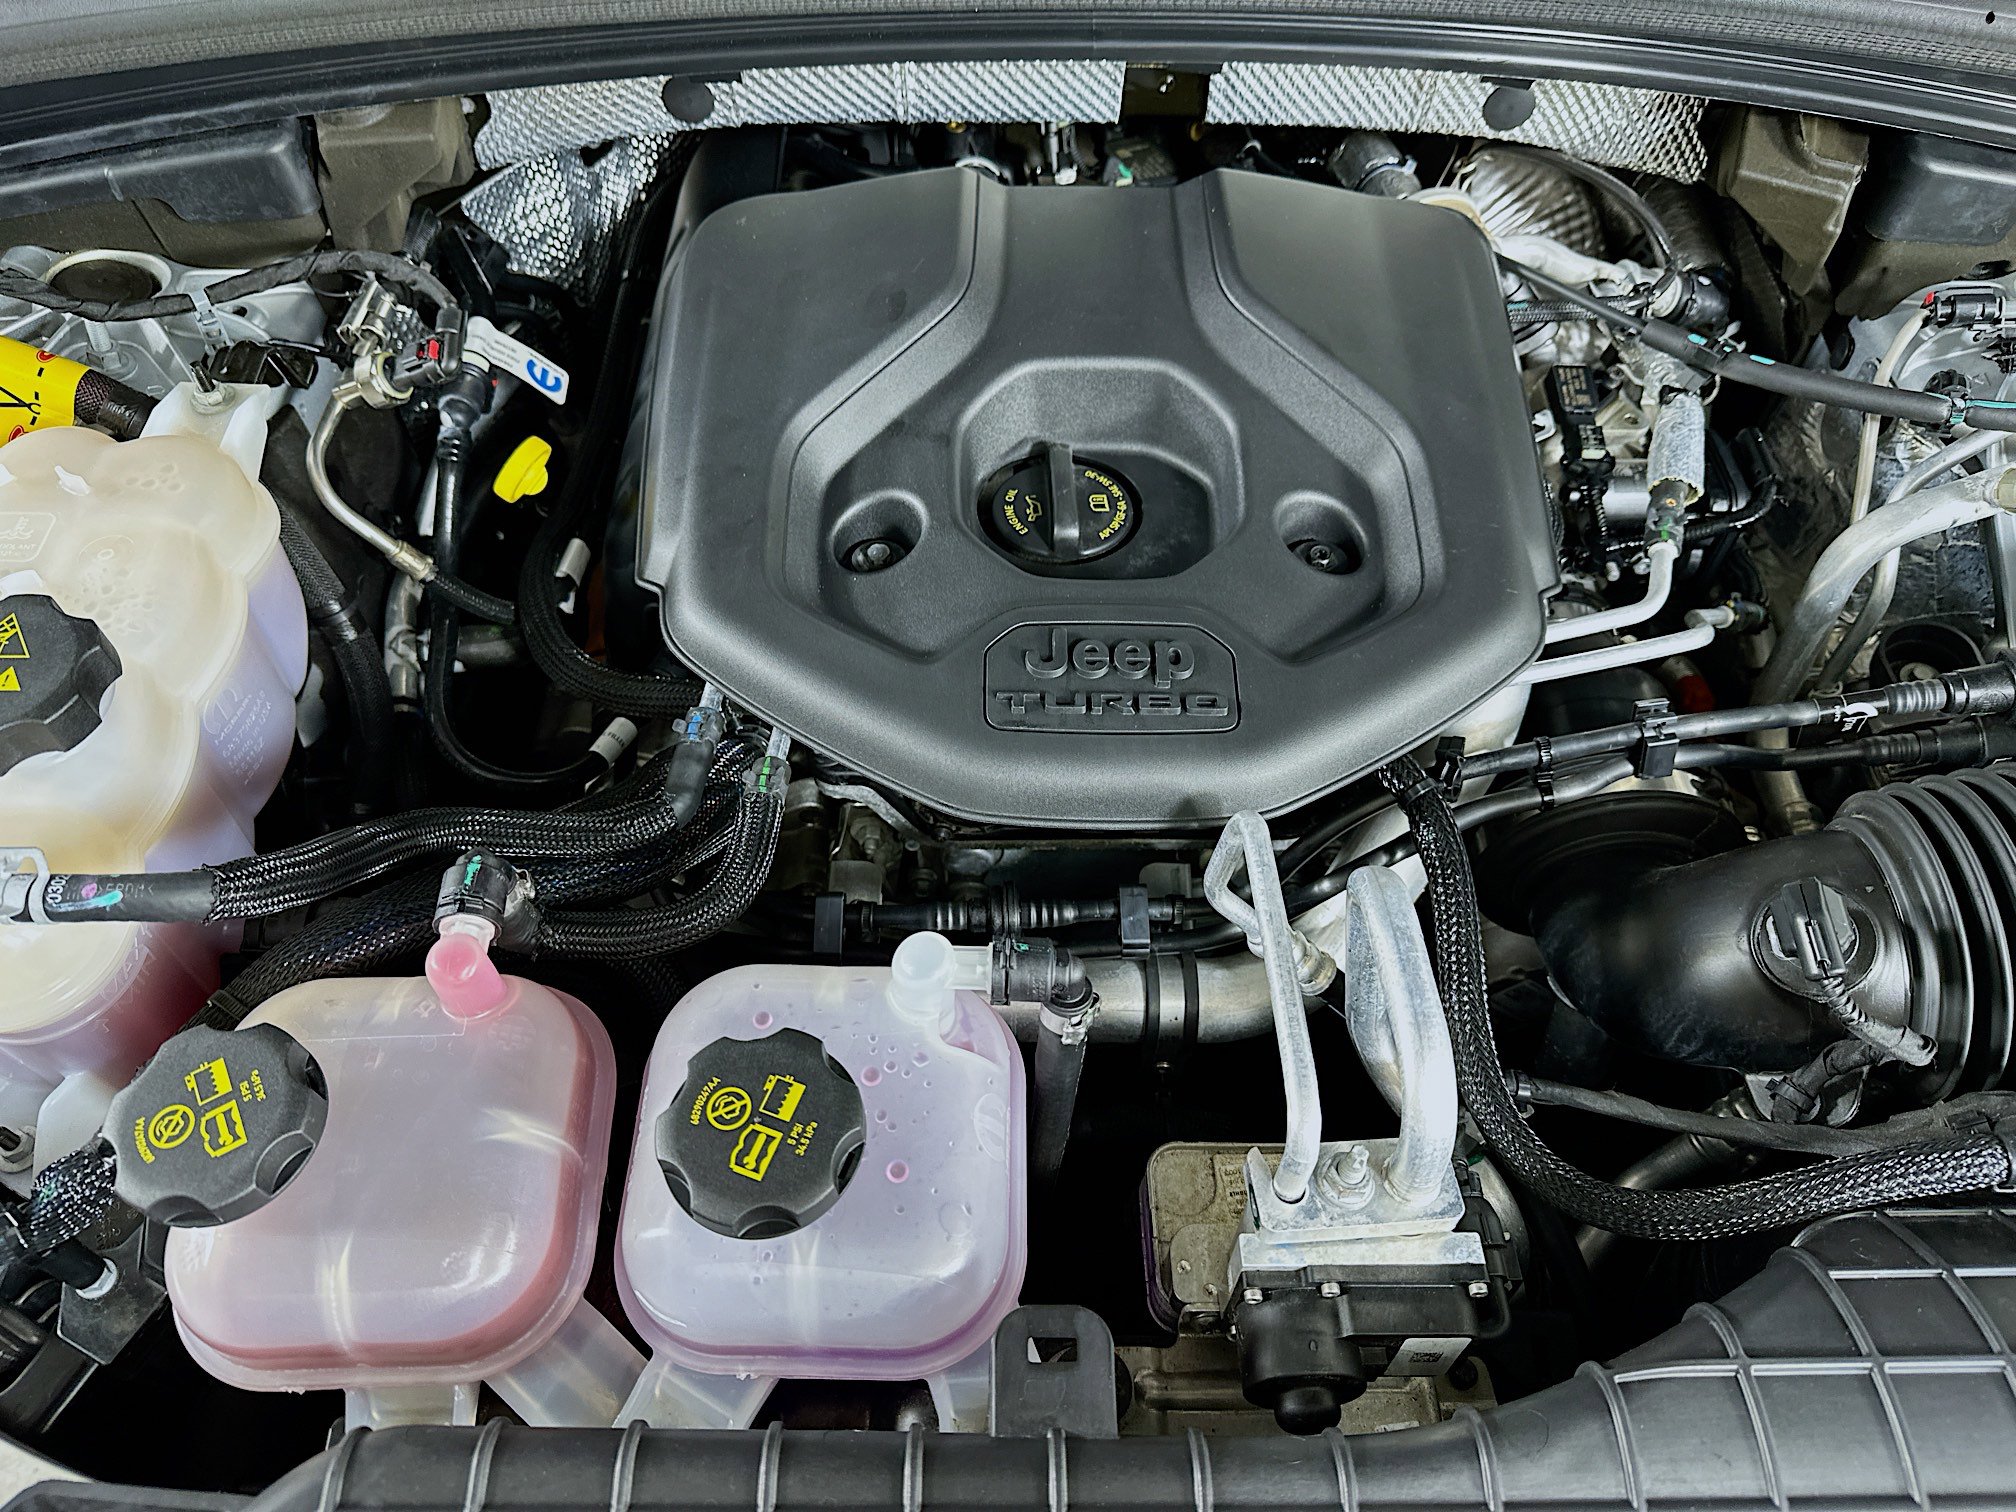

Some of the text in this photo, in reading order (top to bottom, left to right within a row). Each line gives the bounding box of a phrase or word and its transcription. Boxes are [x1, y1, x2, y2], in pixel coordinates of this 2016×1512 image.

[1085, 470, 1112, 488] 5W-30
[1107, 485, 1122, 498] SAE
[1003, 488, 1029, 536] ENGINE OIL
[1098, 527, 1115, 540] API
[1025, 627, 1195, 688] Jeep
[996, 691, 1229, 717] TURBO
[690, 1076, 721, 1125] 68290247AA
[787, 1122, 804, 1146] 5 PSI
[795, 1121, 818, 1156] 34.5 kPa
